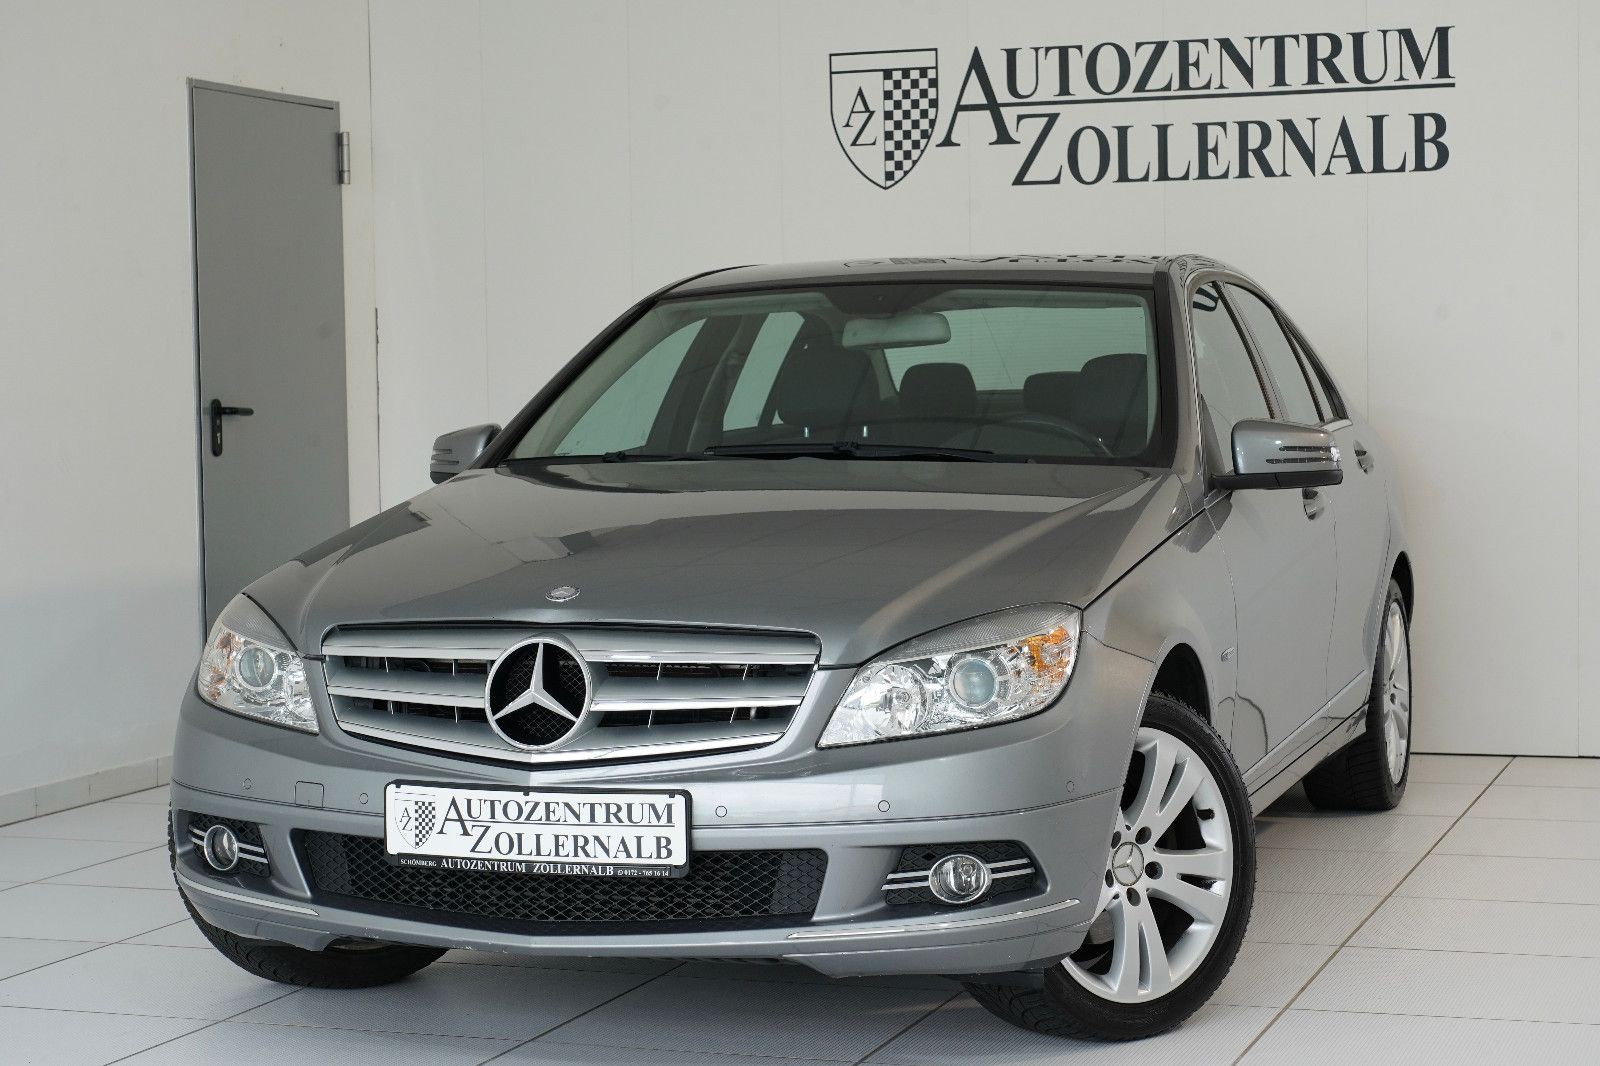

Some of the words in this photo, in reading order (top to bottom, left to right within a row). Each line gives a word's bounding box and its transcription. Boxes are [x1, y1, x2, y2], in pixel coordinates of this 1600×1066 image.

[936, 26, 1456, 148] AUTOZENTRUM
[1011, 112, 1450, 186] ZOLLERNALB
[436, 795, 674, 837] AUTOZENTRUM
[470, 824, 673, 860] ZOLLERNALB
[441, 858, 527, 873] AUTOZENTRUM
[533, 862, 614, 876] ZOLLERNALB
